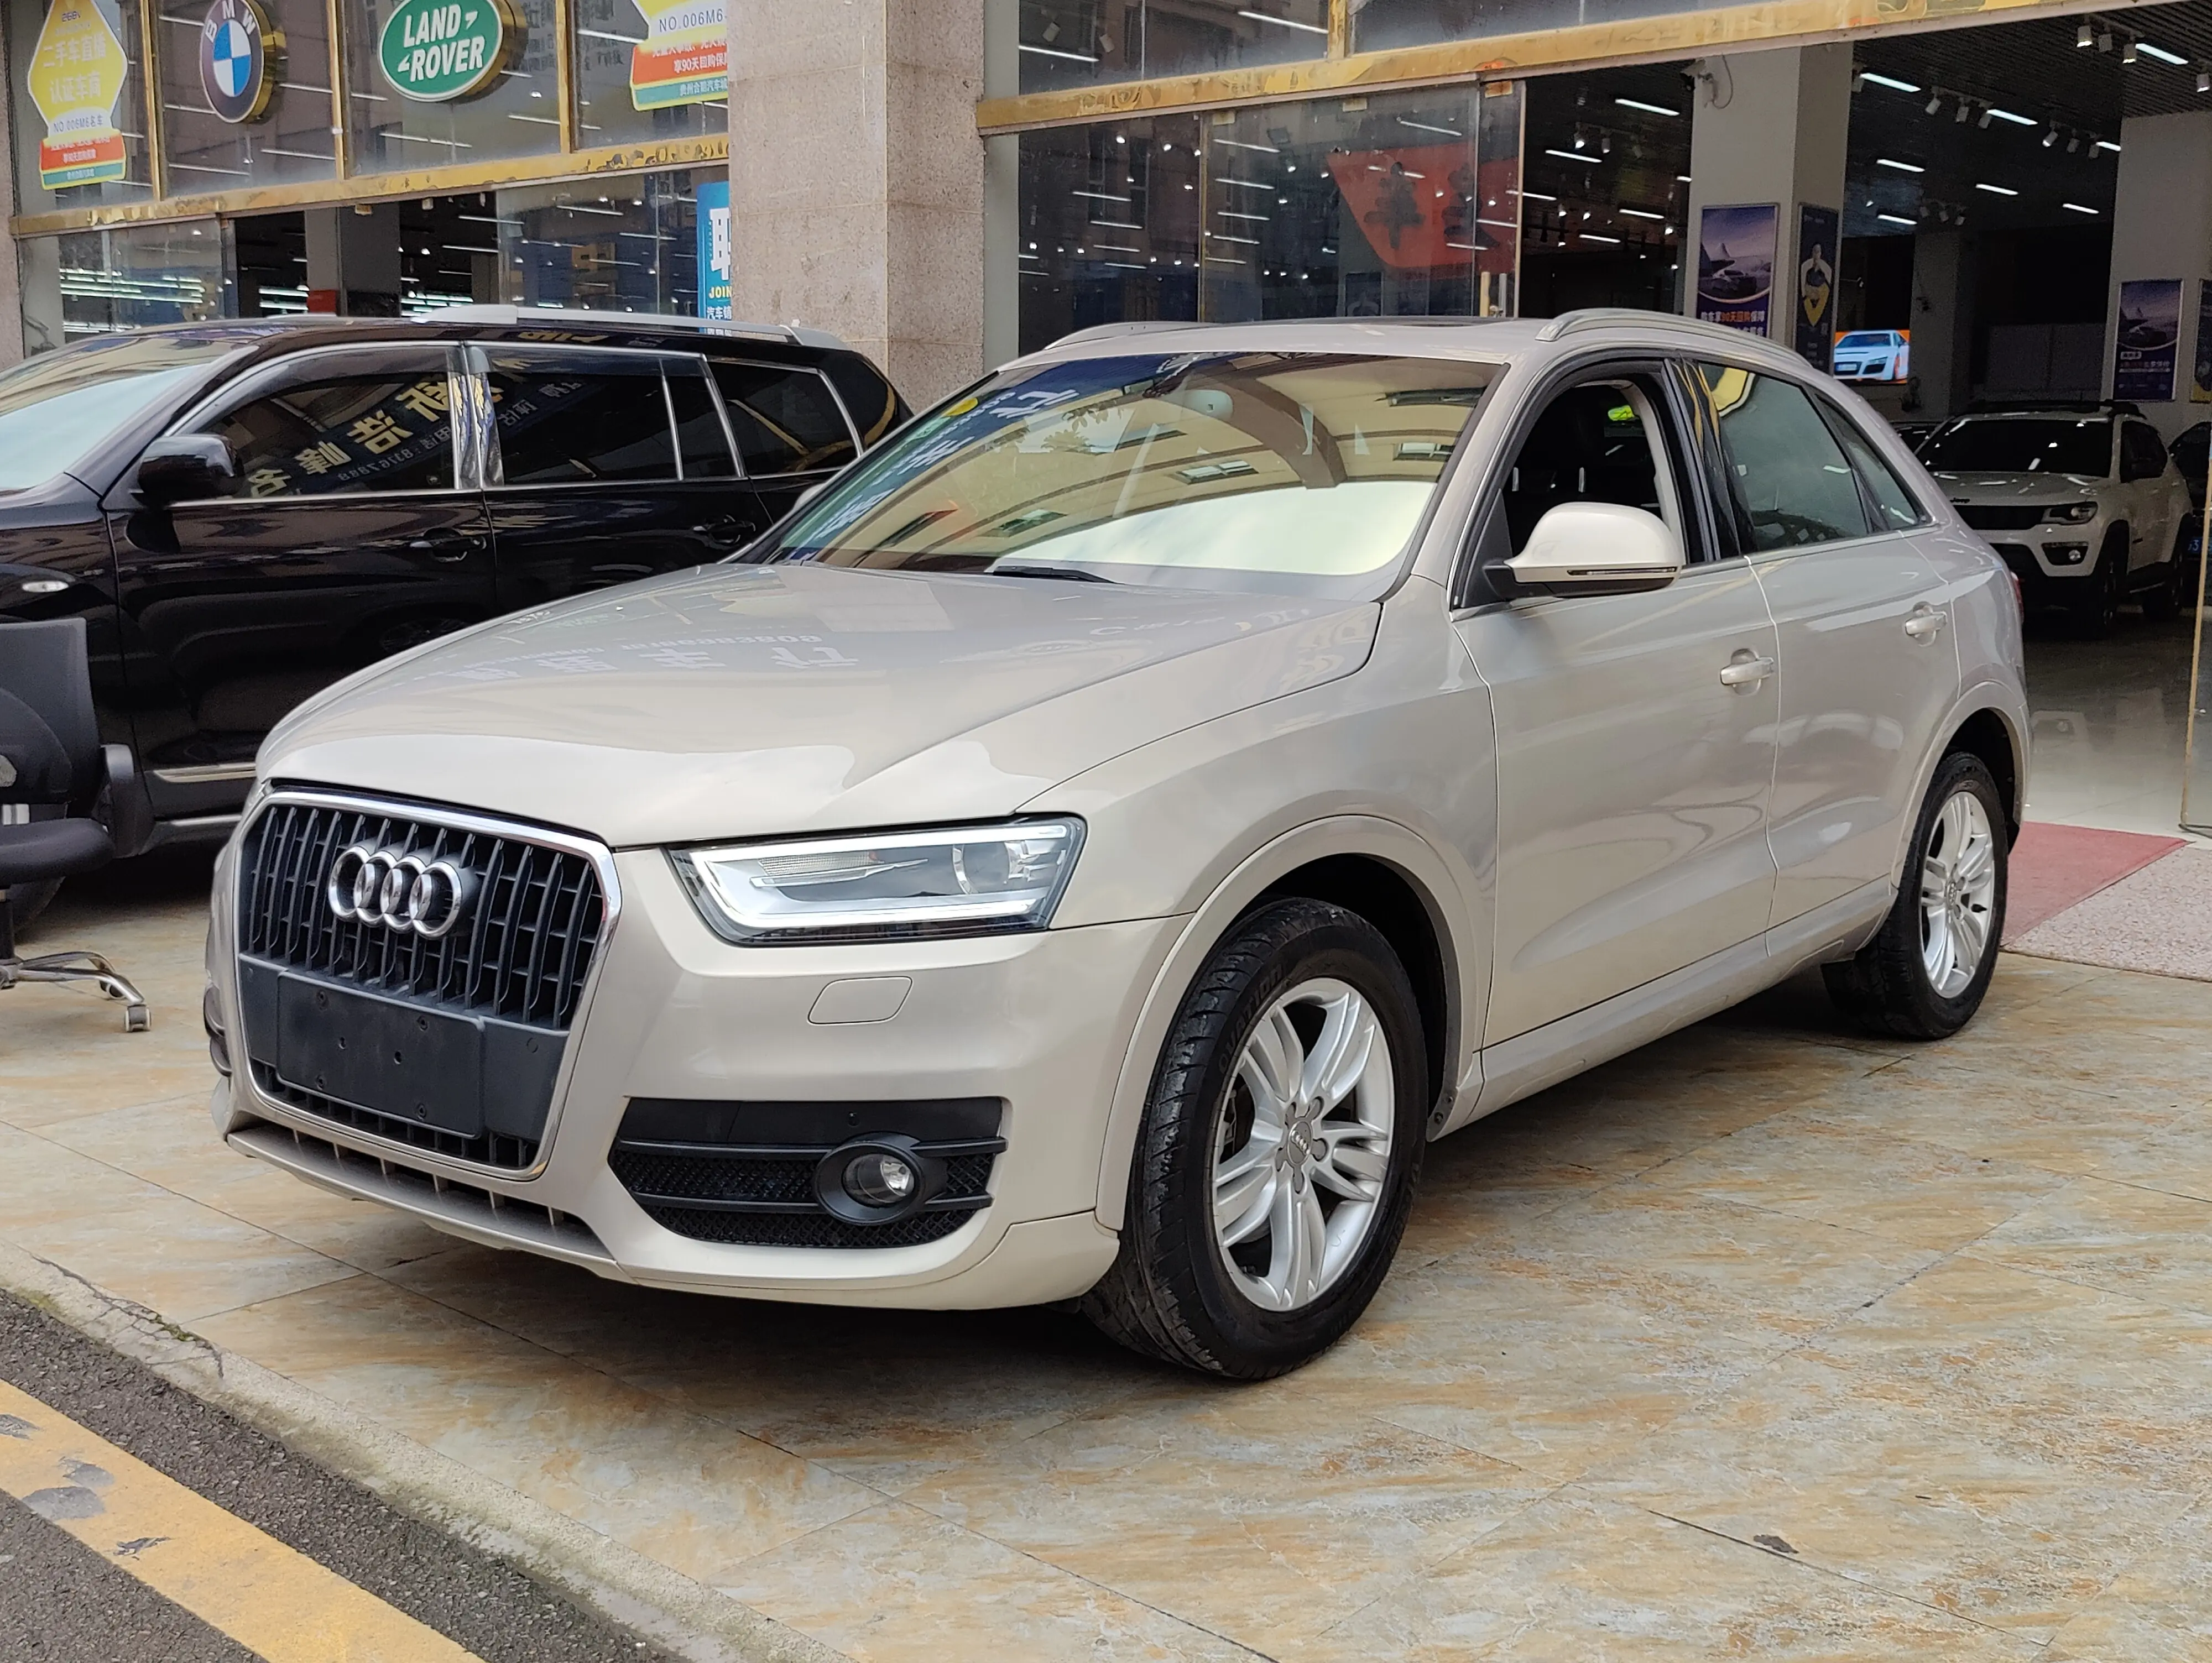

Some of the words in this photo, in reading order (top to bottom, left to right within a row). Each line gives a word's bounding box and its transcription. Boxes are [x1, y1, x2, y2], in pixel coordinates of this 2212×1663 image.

[205, 0, 256, 43] BMW
[404, 4, 461, 48] LAND
[659, 8, 727, 32] NO.006M6
[43, 32, 106, 67] 二手车直播
[410, 36, 485, 82] ROVER
[673, 52, 727, 74] 享90天回购保
[49, 70, 101, 104] 认证车商
